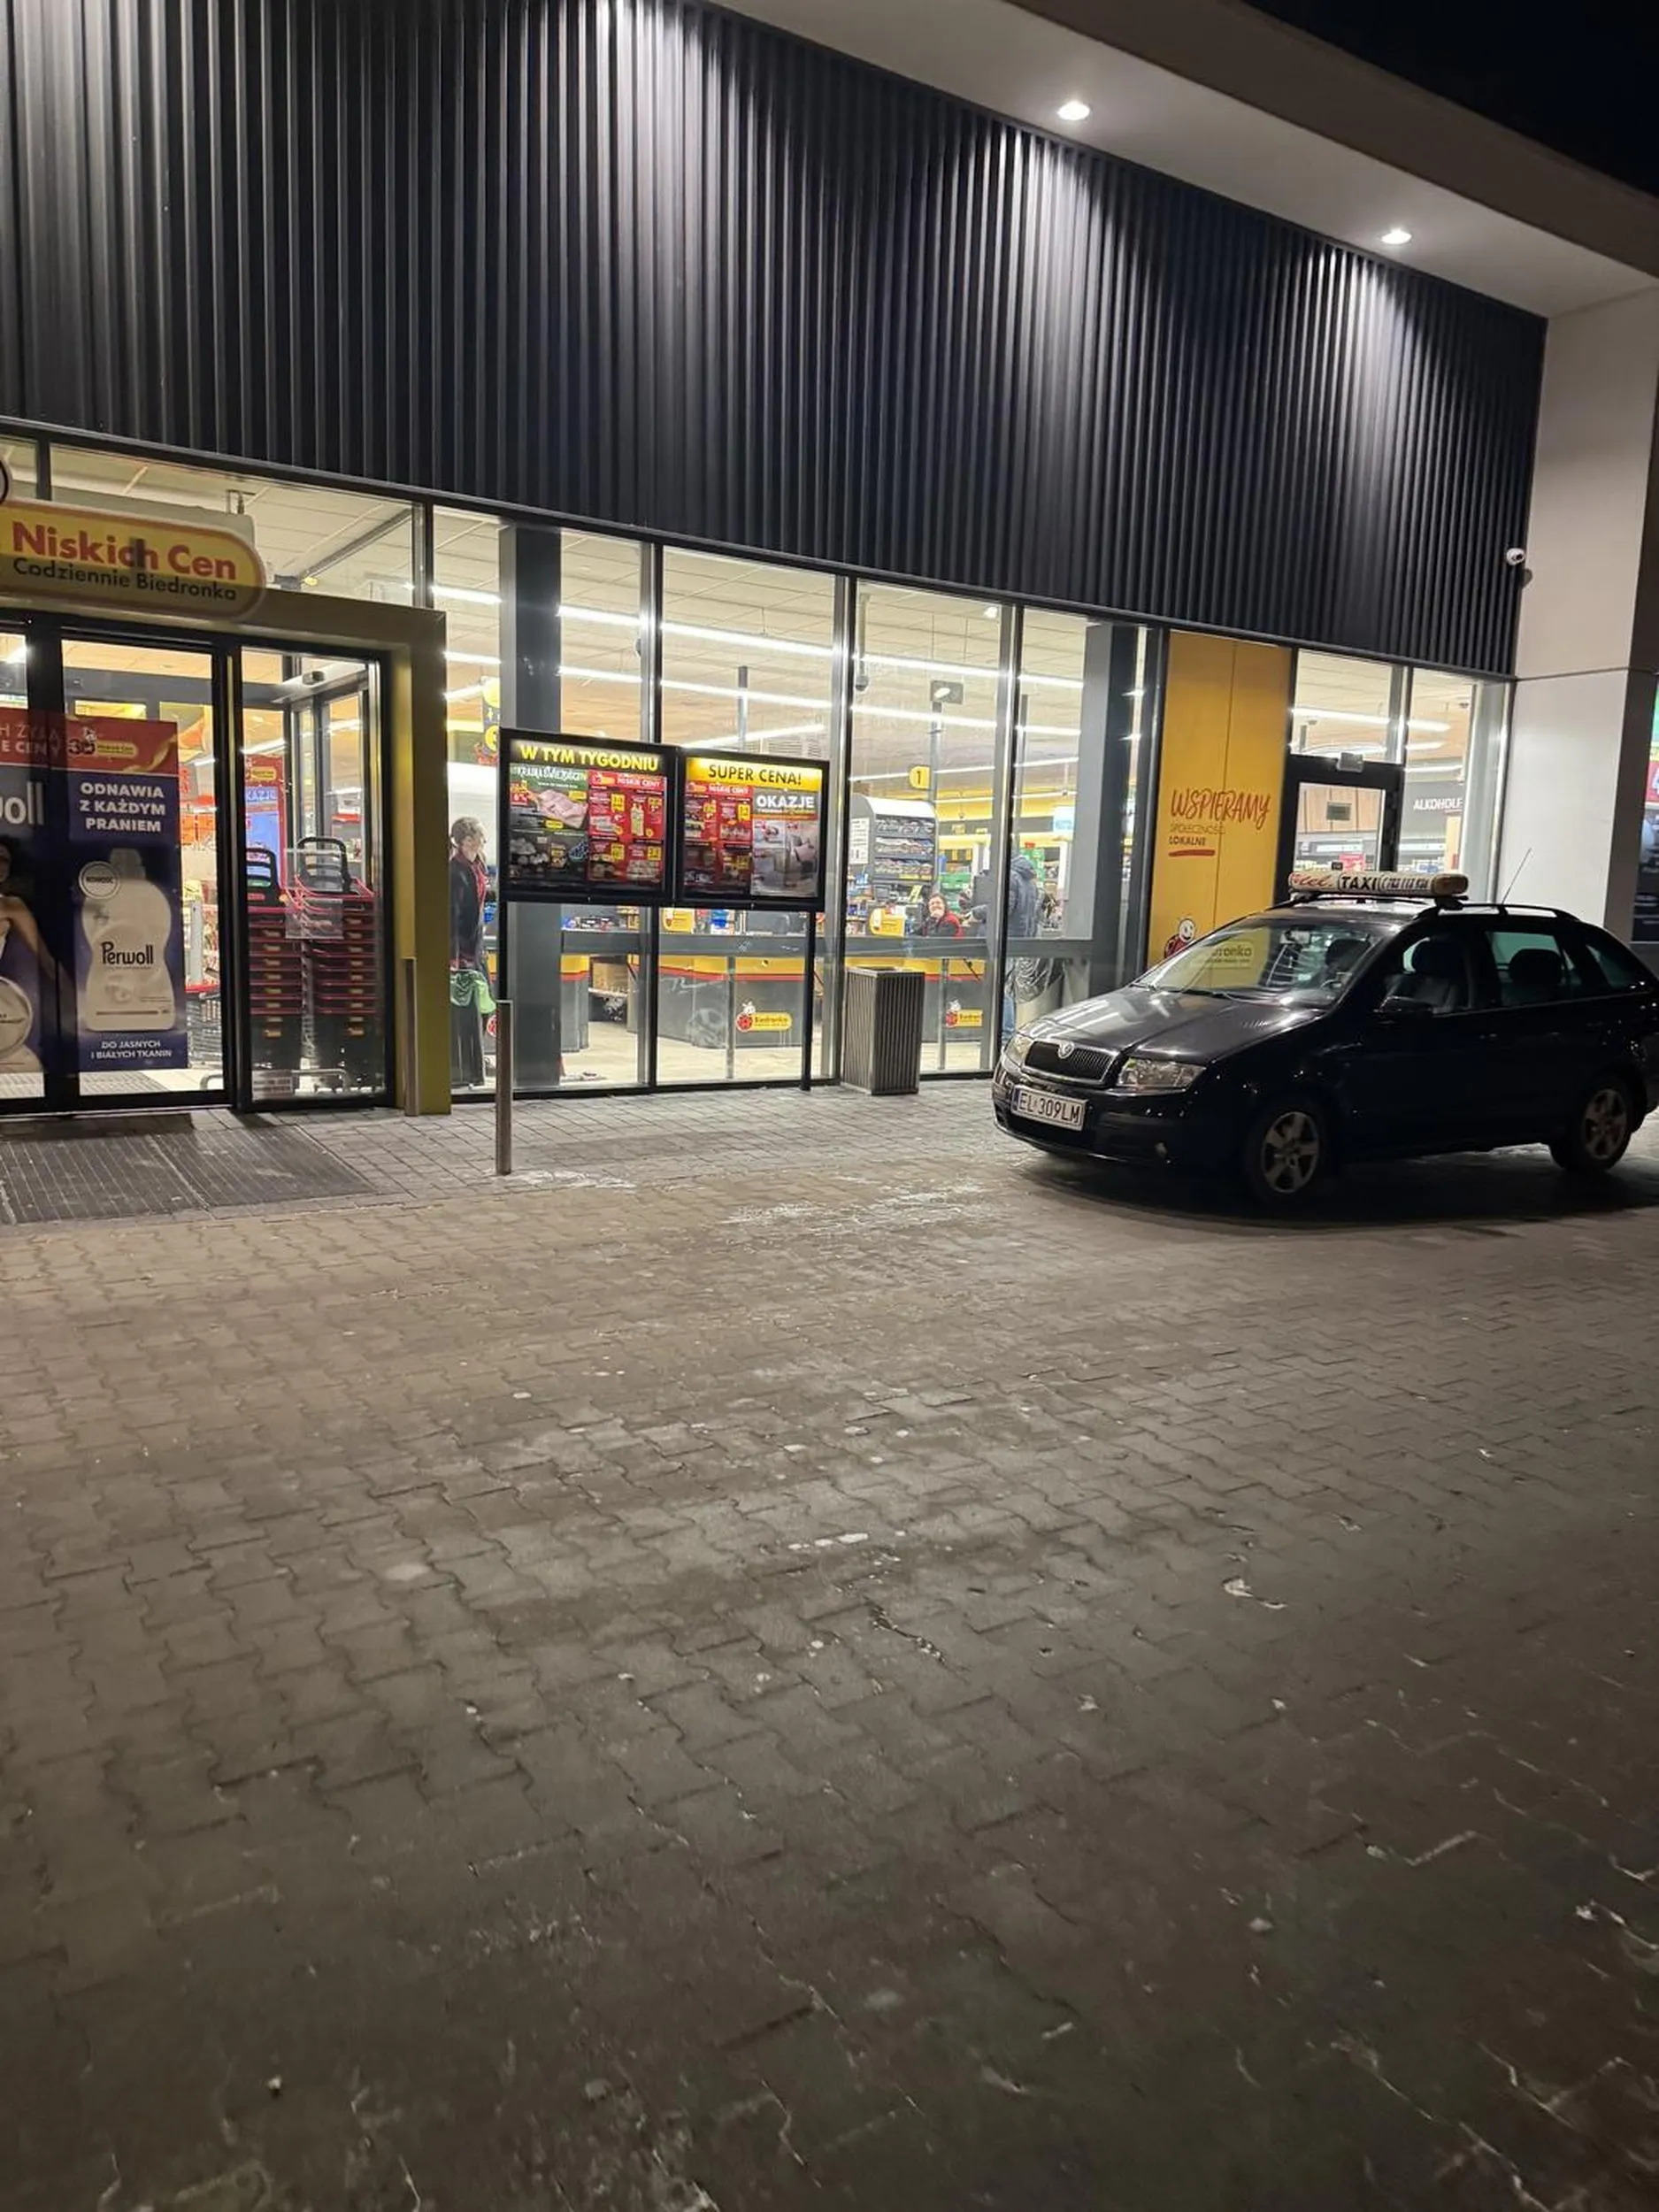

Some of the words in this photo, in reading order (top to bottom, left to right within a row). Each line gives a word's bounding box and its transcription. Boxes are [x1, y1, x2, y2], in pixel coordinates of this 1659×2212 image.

[12, 520, 159, 571] Niskich
[167, 543, 237, 580] Cen
[13, 557, 131, 588] Codziennie
[136, 573, 237, 601] Biedronka
[519, 745, 538, 760] W
[542, 748, 575, 764] TYM
[579, 751, 659, 772] TYGODNIU
[709, 764, 754, 781] SUPER
[759, 769, 802, 786] CENA!
[81, 782, 165, 798] ODNAWIA
[80, 800, 90, 811] Z
[95, 799, 165, 816] KAŻDYM
[757, 795, 815, 808] OKAZJE
[1171, 787, 1271, 830] WSPIERAMY
[86, 818, 162, 832] PRANIEM
[1341, 876, 1377, 891] TAXI
[101, 941, 154, 964] Perwoll
[119, 1040, 160, 1048] JASNYCH
[1019, 1092, 1034, 1118] EL
[1038, 1097, 1079, 1124] 309LM
